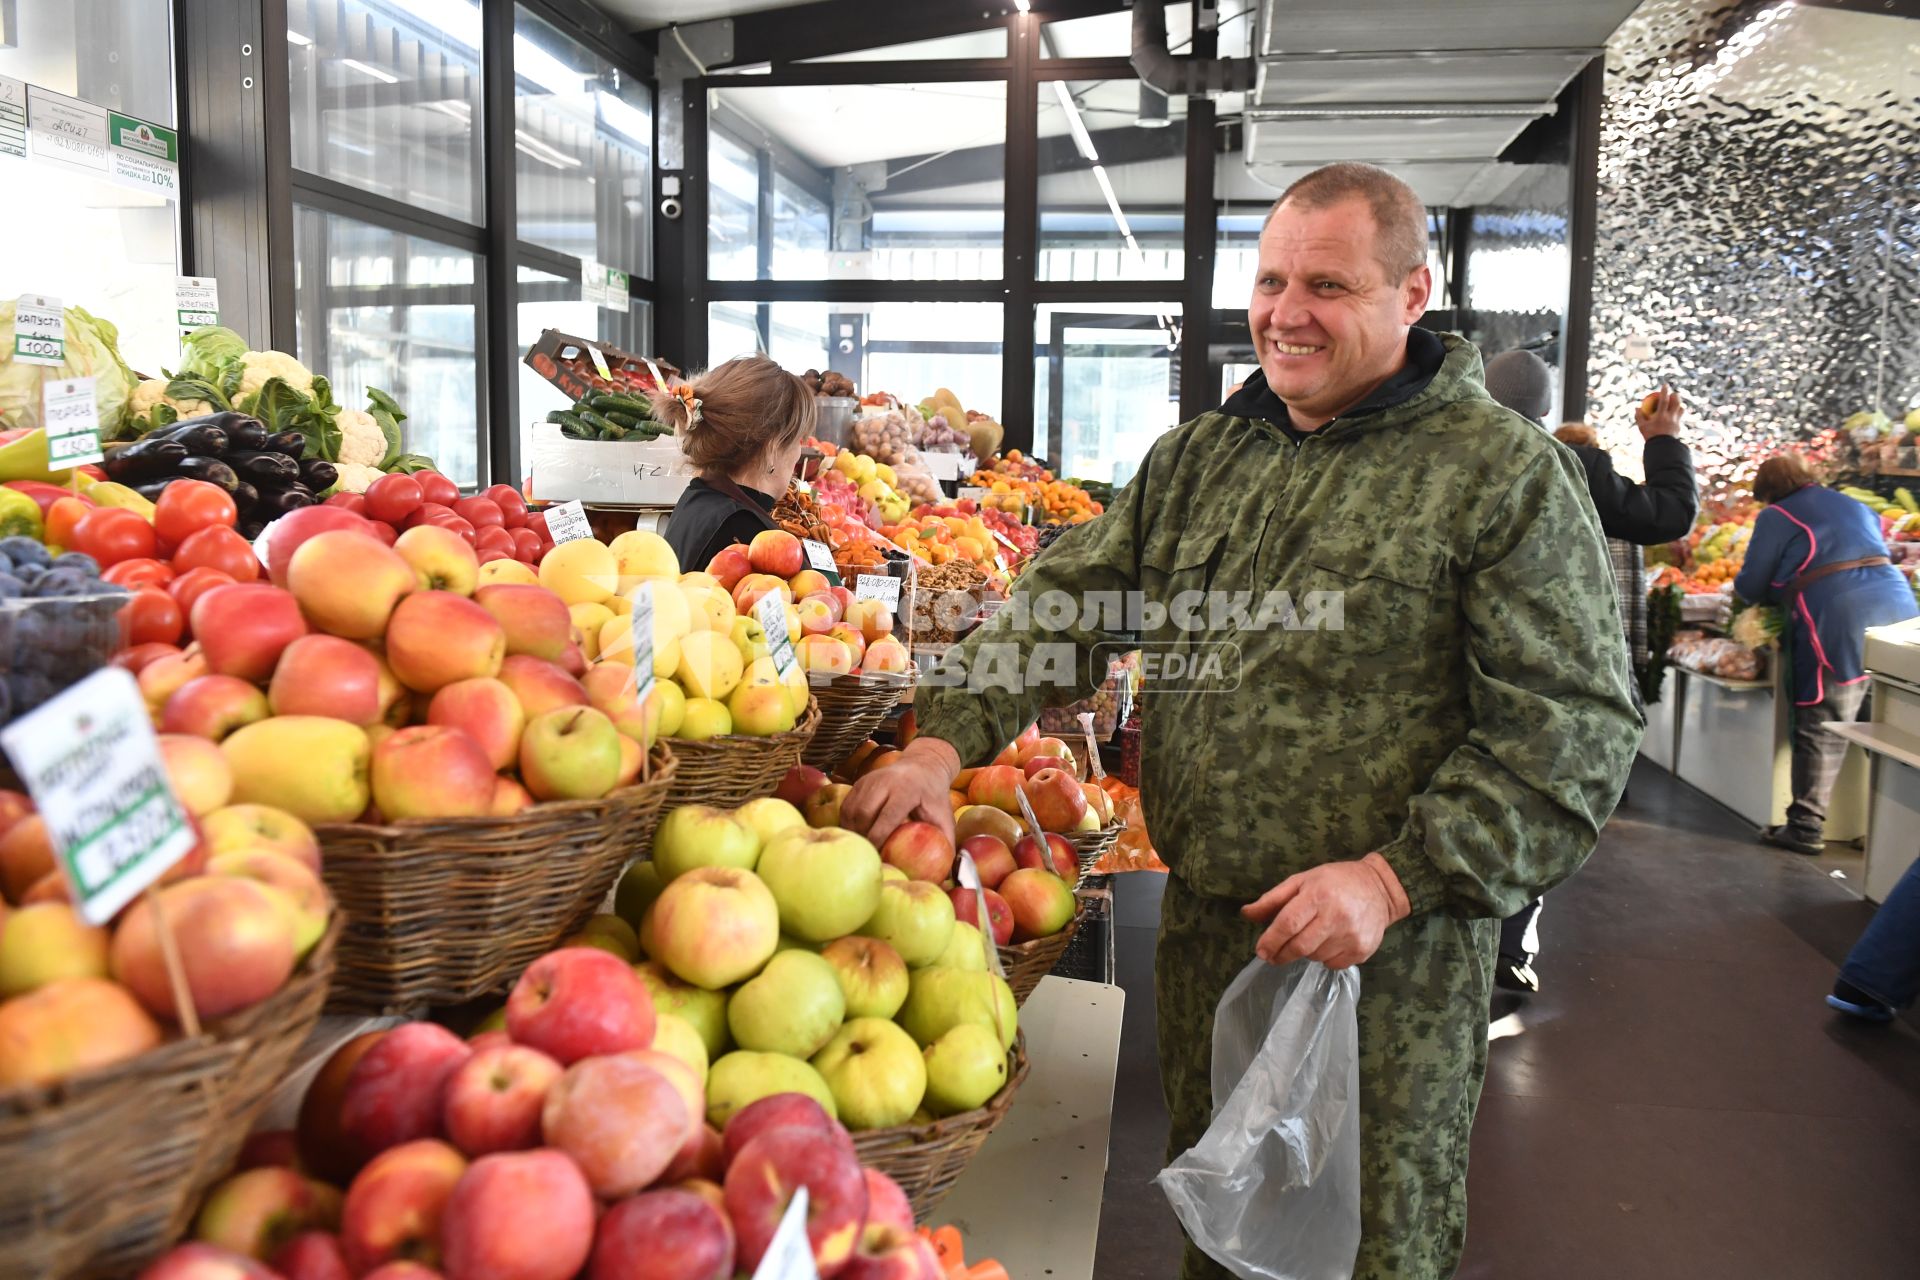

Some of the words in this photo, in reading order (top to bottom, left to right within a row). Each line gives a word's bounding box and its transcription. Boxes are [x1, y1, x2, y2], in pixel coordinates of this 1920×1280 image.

[116, 153, 124, 161] ПО
[125, 155, 159, 171] СОЦИАЛЬНОЙ
[116, 167, 141, 180] СКИДКА
[142, 174, 150, 182] ДО
[151, 171, 174, 189] 10%
[17, 314, 61, 329] КАПУСТА
